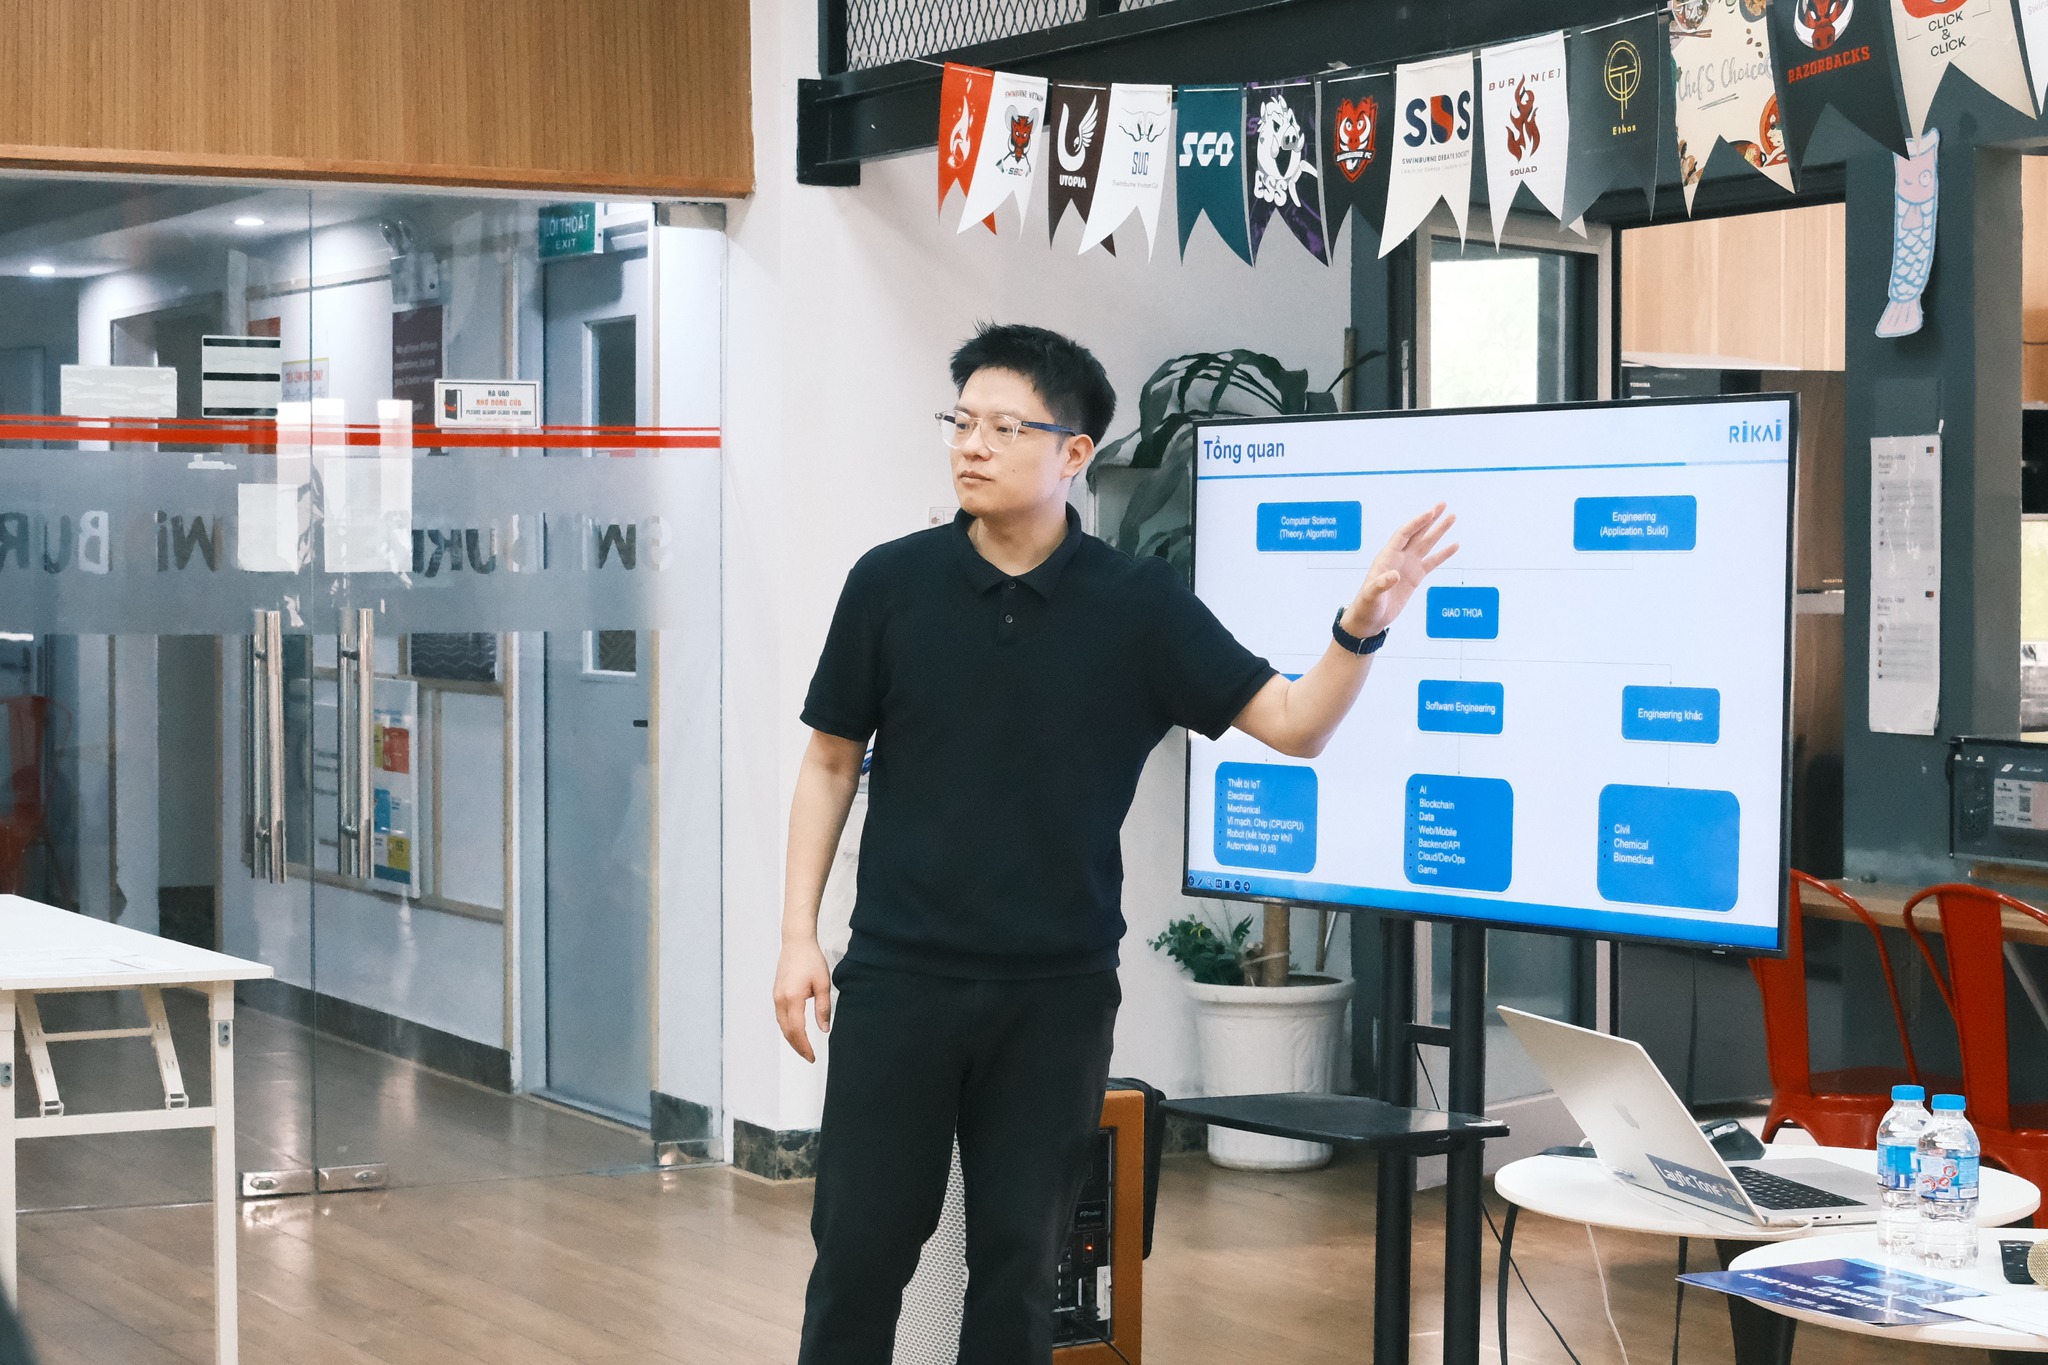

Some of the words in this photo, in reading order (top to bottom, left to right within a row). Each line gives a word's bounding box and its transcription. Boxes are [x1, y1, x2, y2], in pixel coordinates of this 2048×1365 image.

[1929, 11, 1964, 31] CLICK
[1941, 28, 1951, 41] &
[1930, 36, 1967, 57] CLICK
[1787, 45, 1871, 84] RAZORBACKS
[1059, 174, 1087, 188] UTOPIA
[555, 238, 577, 250] EXIT
[1204, 435, 1242, 465] Tổng
[1247, 442, 1285, 464] quan
[1281, 515, 1311, 527] Computer
[1311, 515, 1337, 525] Science
[1612, 511, 1657, 524] Engineering
[1280, 528, 1305, 541] (Theory,
[1305, 528, 1338, 541] Algorithm)
[1600, 526, 1645, 538] (Application,
[1646, 525, 1669, 538] Build)
[1441, 607, 1461, 618] GIAO
[1461, 607, 1483, 618] THOA
[1425, 700, 1454, 711] Software
[1455, 702, 1496, 716] Engineering
[1637, 708, 1682, 722] Engineering
[1684, 710, 1703, 721] khác
[1227, 790, 1255, 801] Electrical
[1419, 785, 1427, 795] AI
[1227, 803, 1261, 815] Mechanical
[1419, 798, 1455, 810] Blockchain
[1419, 811, 1435, 822] Data
[1254, 817, 1268, 829] Chip
[1269, 819, 1304, 832] (CPU/GPU)
[1418, 825, 1458, 837] Web/Mobile
[1614, 823, 1631, 834] Civil
[1226, 828, 1245, 839] Robot
[1226, 840, 1260, 852] Automotive
[1418, 838, 1460, 850] Backend/API
[1613, 837, 1649, 850] Chemical
[1417, 851, 1466, 865] Cloud/DevOps
[1613, 851, 1655, 865] Biomedical
[1417, 864, 1438, 875] Game
